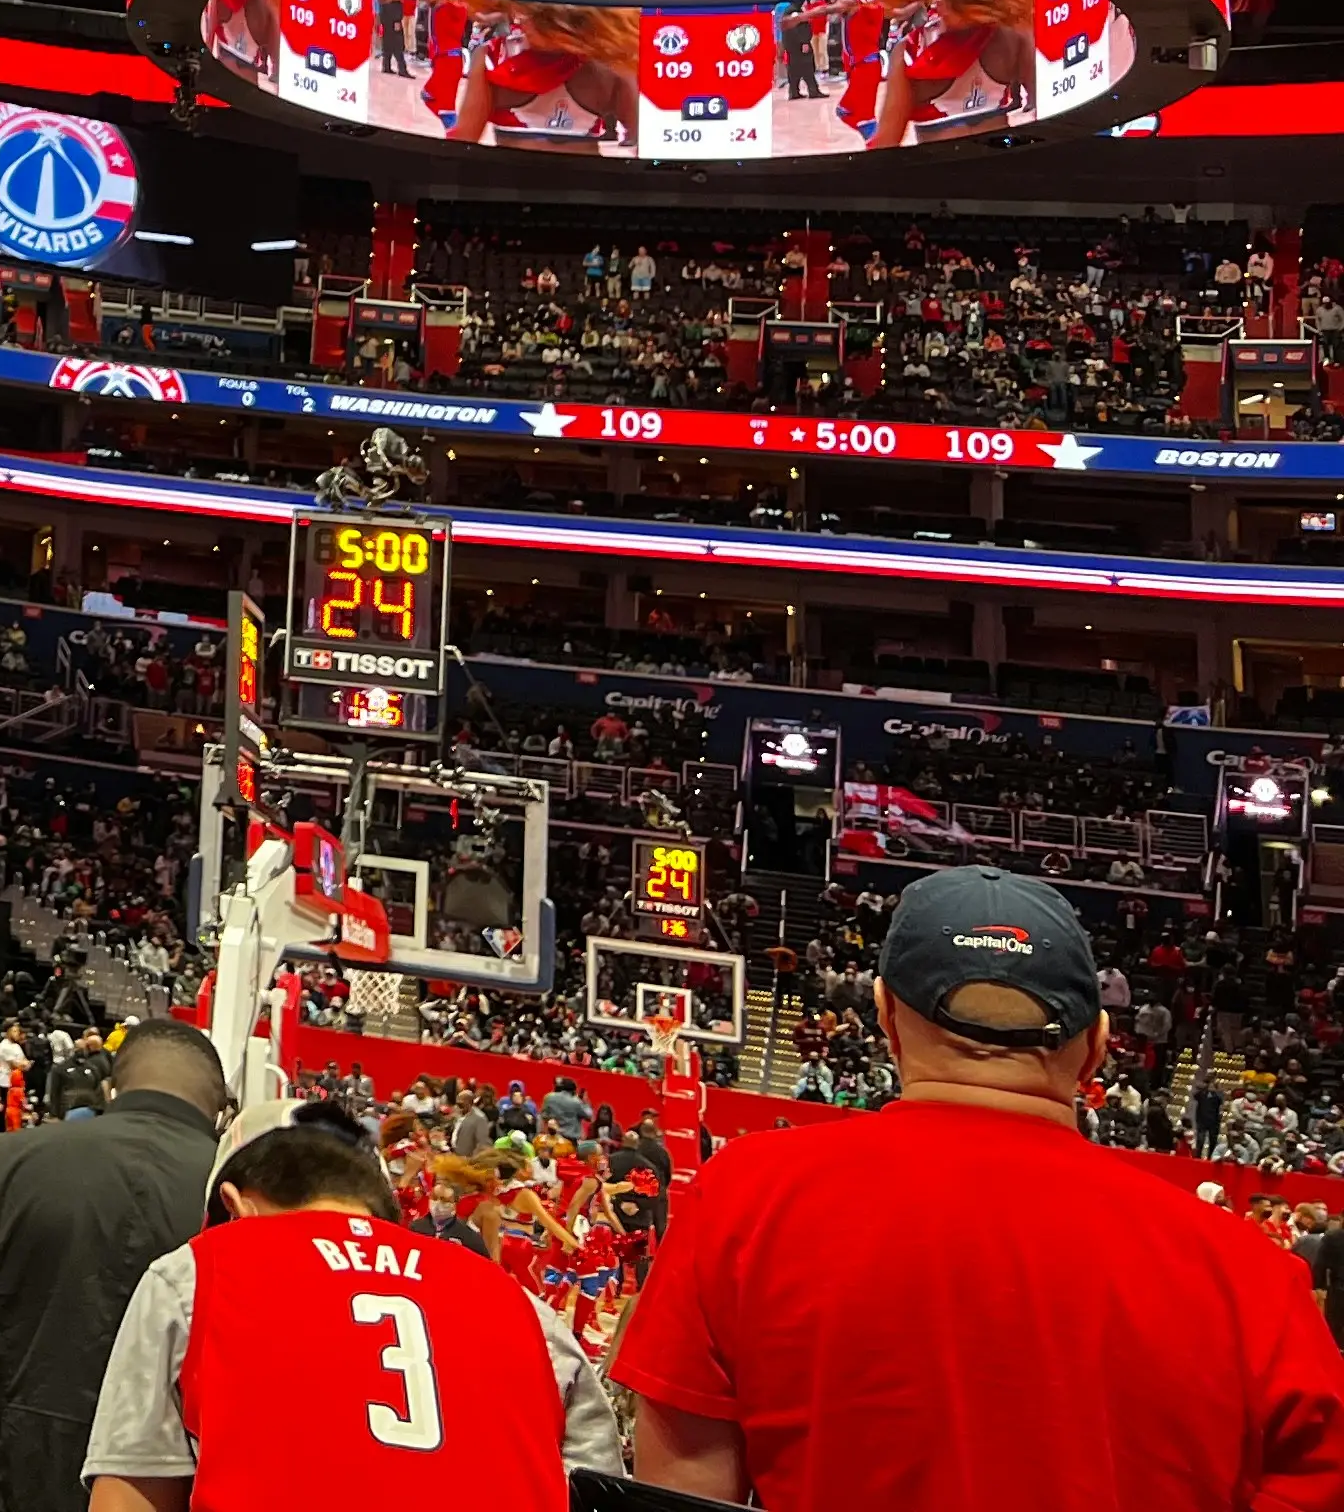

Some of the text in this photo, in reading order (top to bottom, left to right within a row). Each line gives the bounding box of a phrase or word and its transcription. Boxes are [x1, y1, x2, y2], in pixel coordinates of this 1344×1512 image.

[289, 4, 315, 27] 109
[1043, 2, 1070, 27] 109
[328, 17, 357, 40] 109
[653, 61, 693, 79] 109
[715, 59, 754, 78] 109
[293, 72, 318, 93] 5:00
[1052, 74, 1076, 97] 5:00
[662, 128, 702, 143] 5:00
[218, 377, 258, 392] FOULS
[329, 394, 663, 440] WASHINGTON 109
[815, 422, 1281, 470] 5:00 109 BOSTON
[337, 528, 430, 574] 5:00
[322, 570, 415, 639] 24
[333, 651, 435, 680] TISSOT
[653, 847, 698, 872] 5:00
[646, 865, 690, 900] 24
[311, 1236, 424, 1282] BEAL
[350, 1291, 445, 1453] 3
